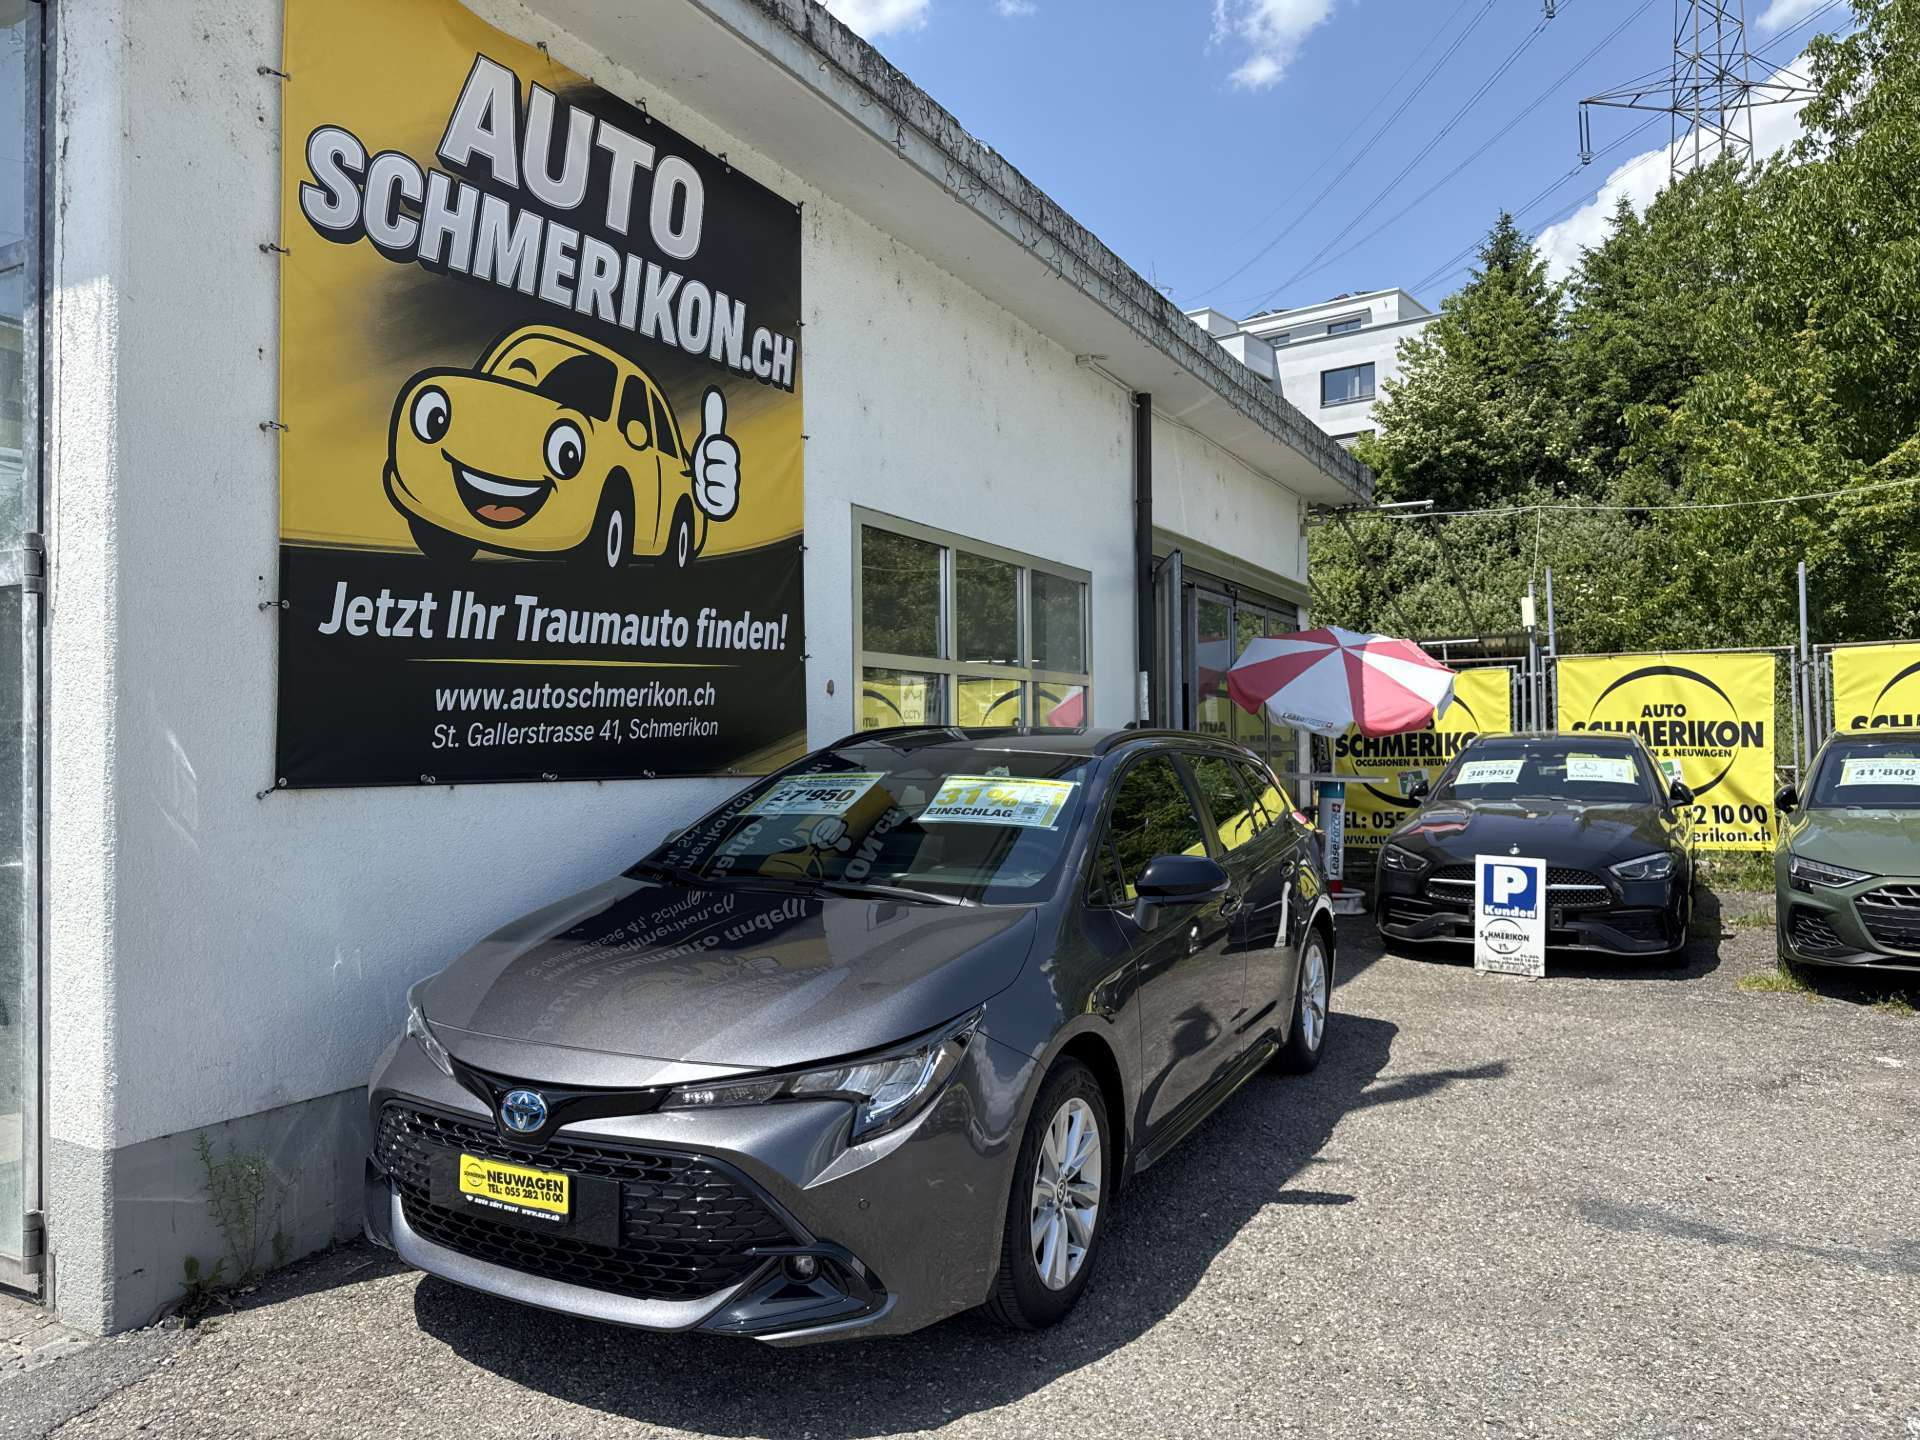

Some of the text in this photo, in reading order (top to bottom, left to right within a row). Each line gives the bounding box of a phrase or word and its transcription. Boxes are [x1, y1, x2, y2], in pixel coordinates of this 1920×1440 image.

[438, 53, 704, 260] AUTO
[300, 126, 795, 387] SCHMERIKON.CH
[318, 581, 788, 650] Jetzt Ihr Traumauto finden!
[435, 681, 715, 711] www.autoschmerikon.ch
[1641, 704, 1686, 718] AUTO
[432, 718, 718, 749] St. Gallerstrasse 41, Schmerikon
[1355, 758, 1411, 767] OCCASIONEN
[1662, 749, 1670, 757] &
[1674, 748, 1732, 758] NEUWAGEN
[1855, 768, 1916, 776] 41'800
[770, 788, 857, 802] 27'950
[936, 787, 1019, 807] 31%
[926, 807, 1014, 818] EINSCHLAG
[1344, 812, 1366, 829] EL:
[1711, 804, 1735, 824] 10
[1738, 804, 1768, 824] 00
[1493, 865, 1528, 904] P
[1484, 903, 1536, 918] Kunden
[1479, 930, 1530, 942] SHMERIKON
[487, 1170, 563, 1193] NEUWAGEN
[487, 1183, 564, 1203] TEL: 055 282 10 00
